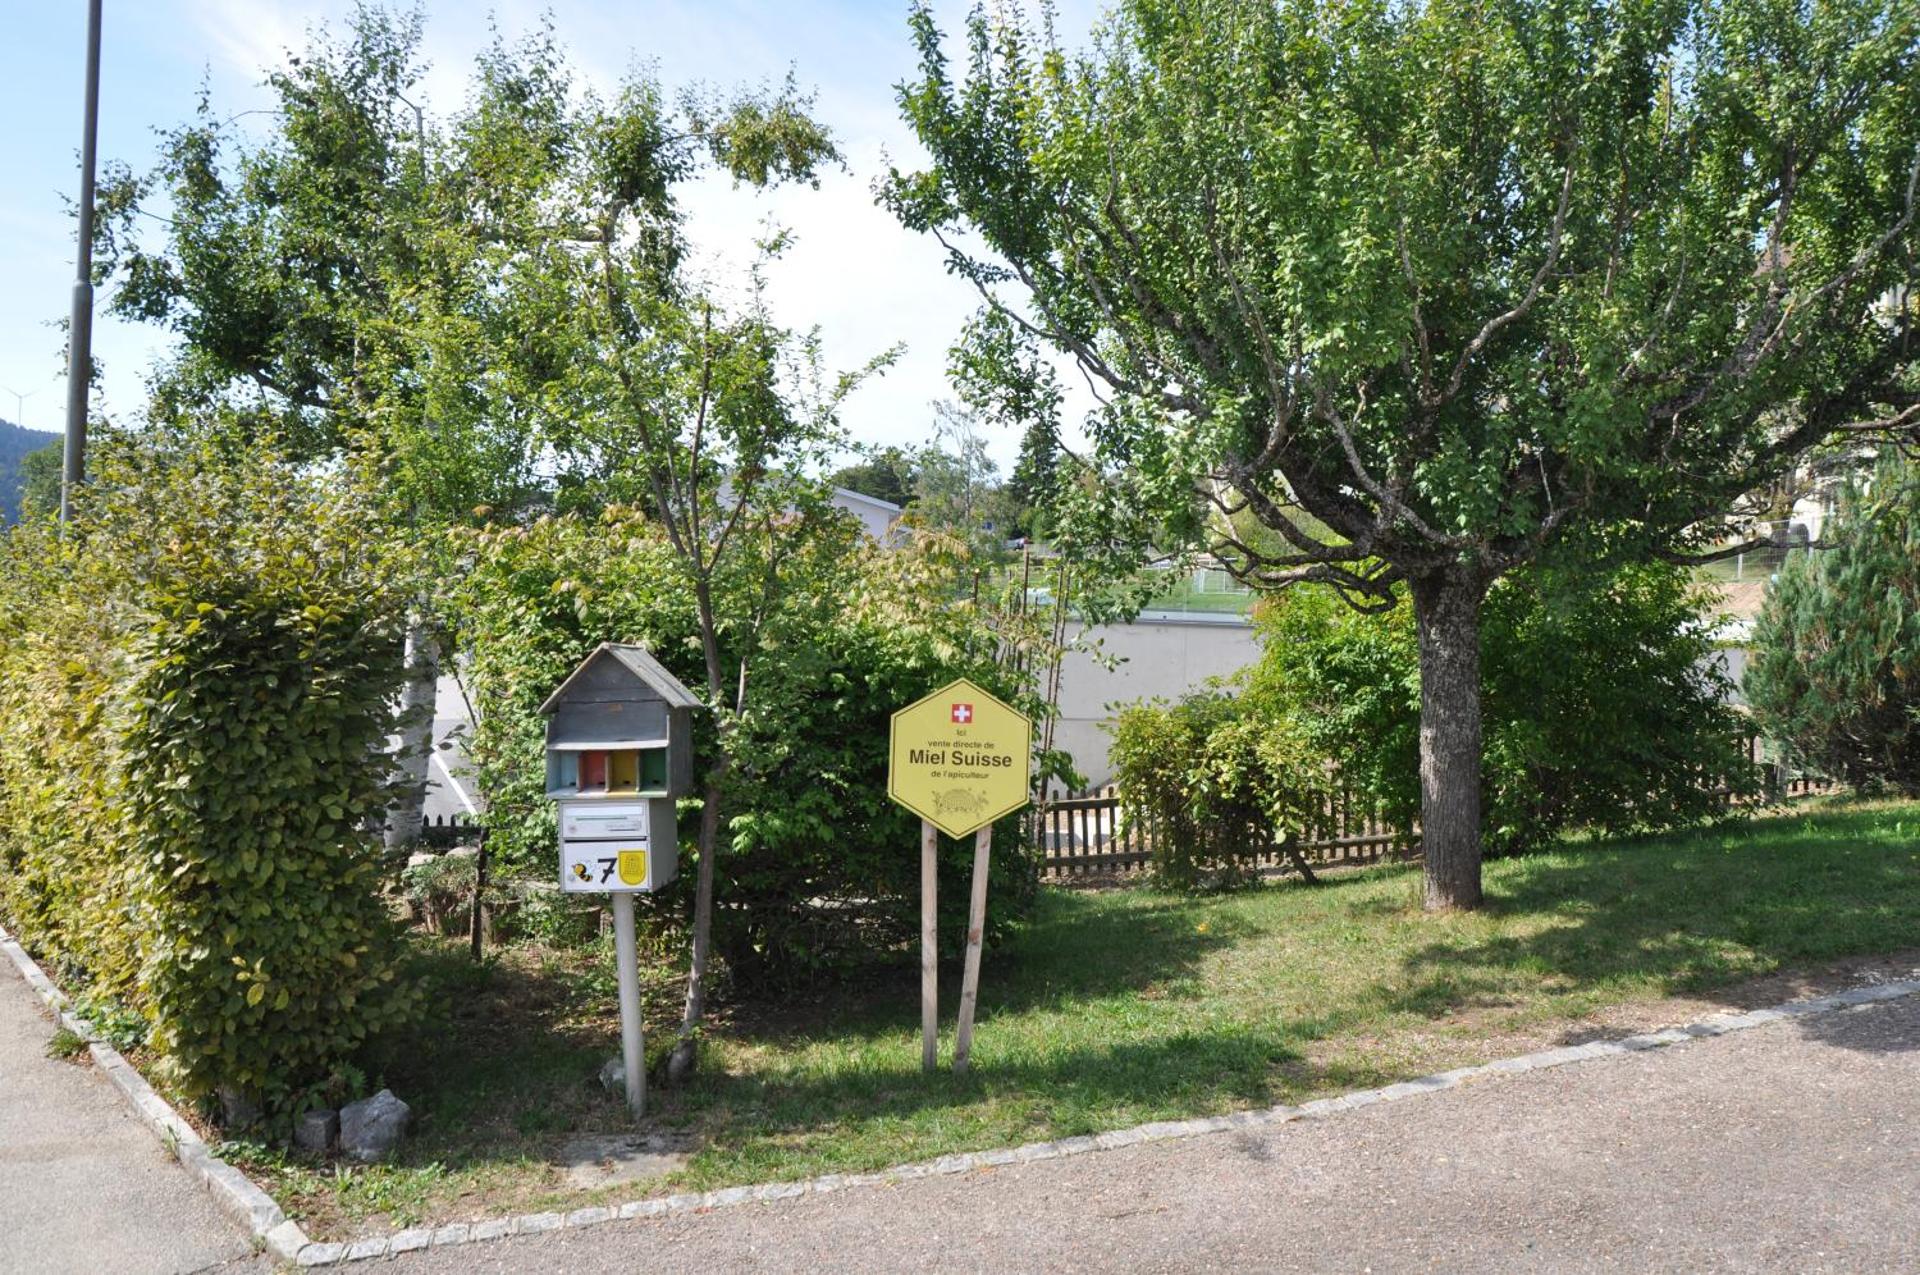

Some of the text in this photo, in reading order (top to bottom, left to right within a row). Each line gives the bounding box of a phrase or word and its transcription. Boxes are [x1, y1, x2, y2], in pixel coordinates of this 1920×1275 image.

[928, 740, 995, 749] vente directe de
[909, 749, 1012, 767] Miel Suisse
[931, 770, 941, 778] de
[597, 857, 618, 884] 7
